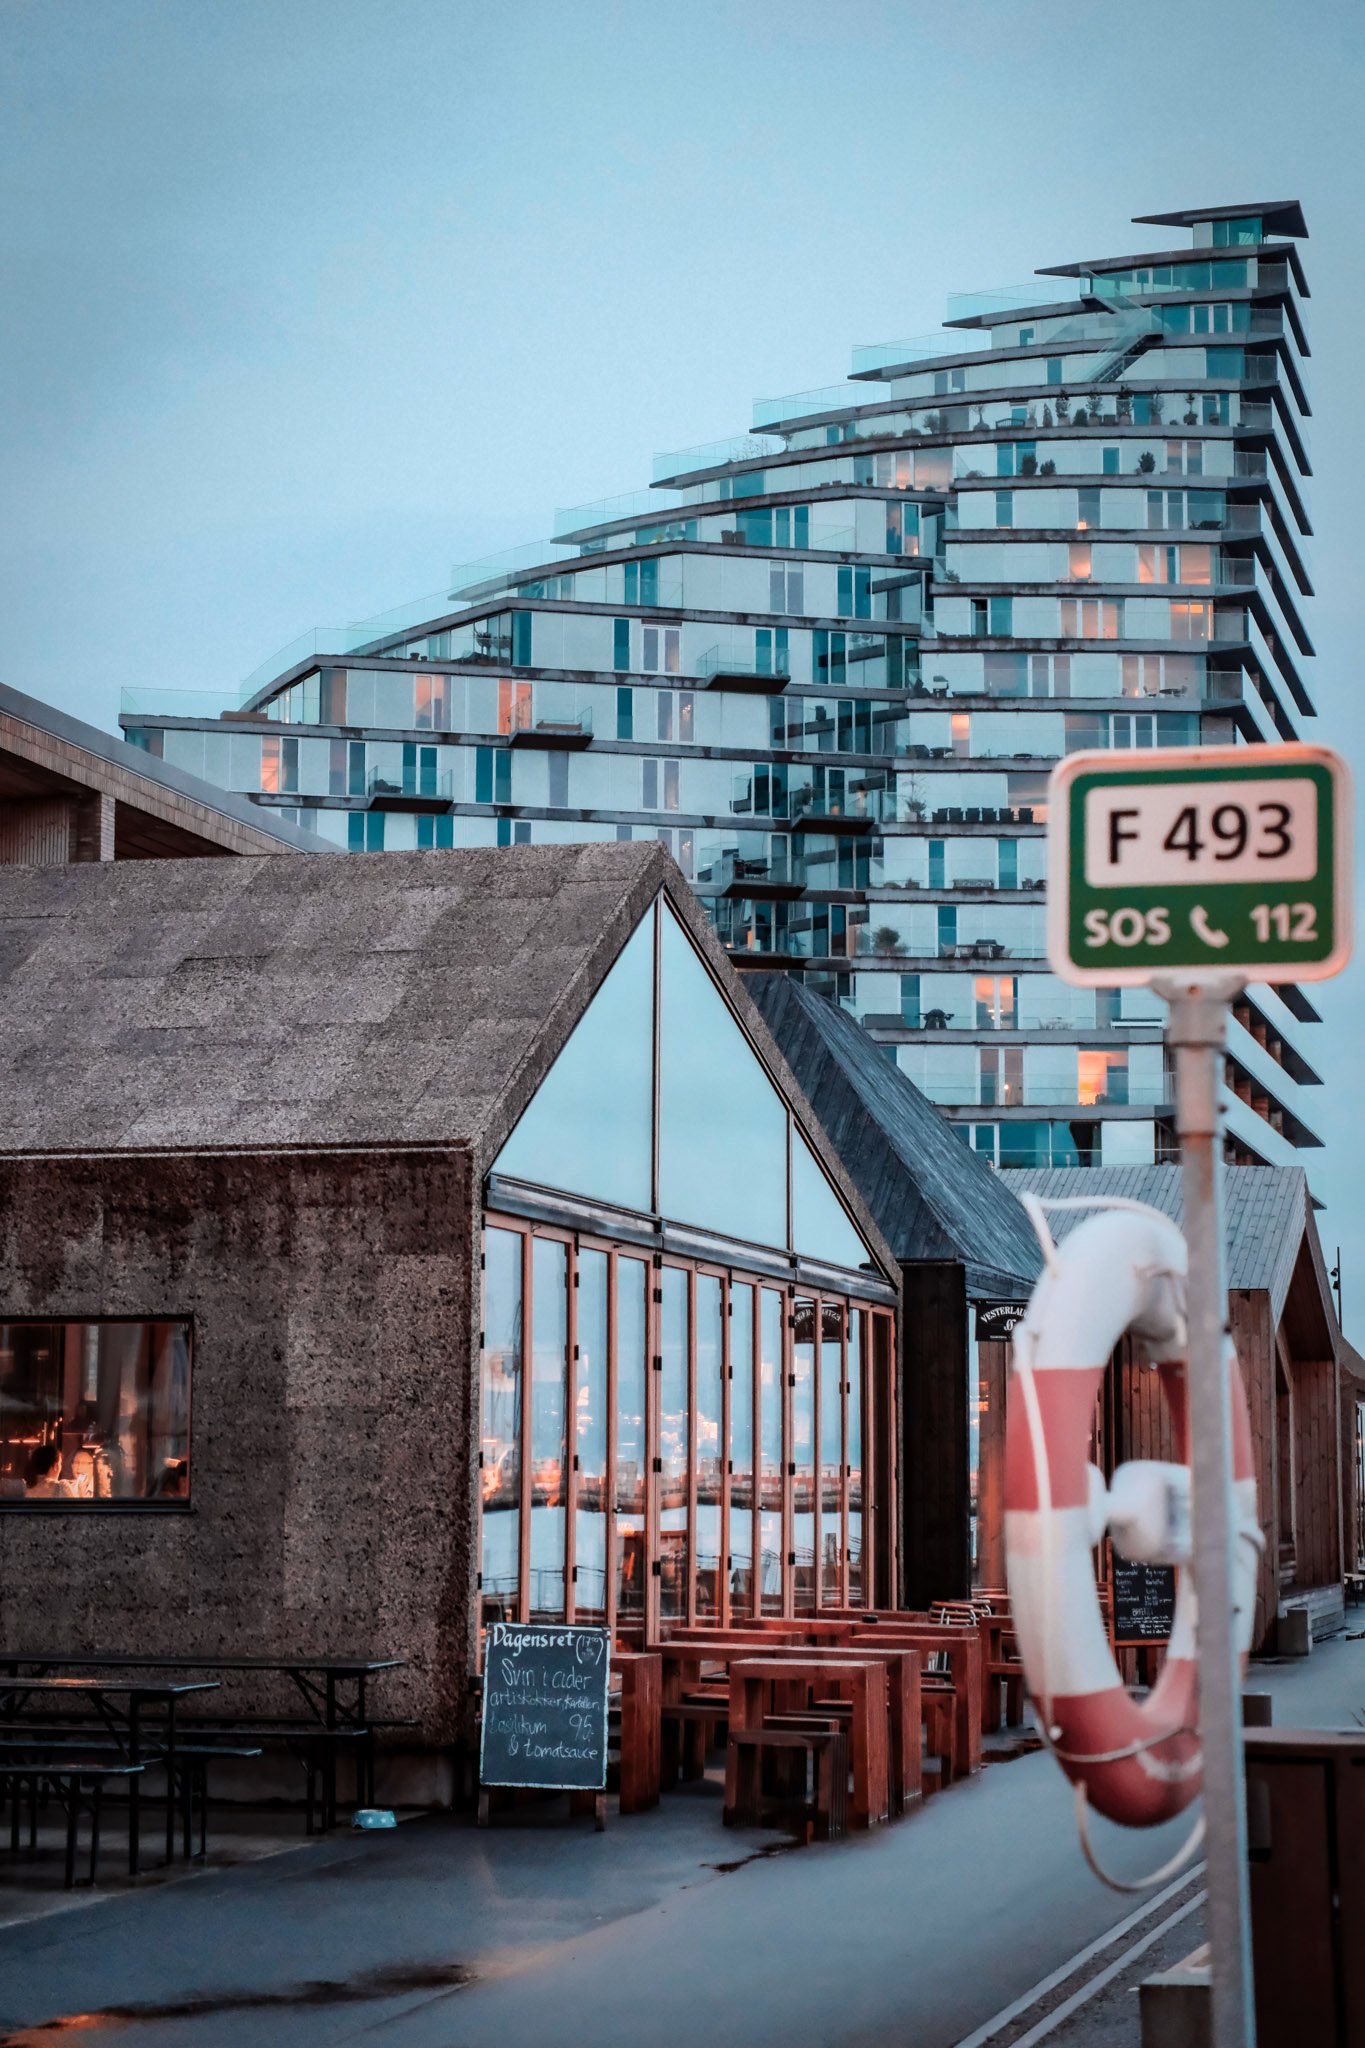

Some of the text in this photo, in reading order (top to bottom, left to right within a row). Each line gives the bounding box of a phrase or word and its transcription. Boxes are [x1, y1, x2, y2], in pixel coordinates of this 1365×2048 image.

[1109, 802, 1293, 864] F 493
[1083, 902, 1318, 948] SOS 112
[980, 1305, 1027, 1323] VESTERLAU
[493, 1624, 575, 1656] Dagensret
[501, 1658, 592, 1690] Svin i cider
[523, 1737, 598, 1760] tomatsauce
